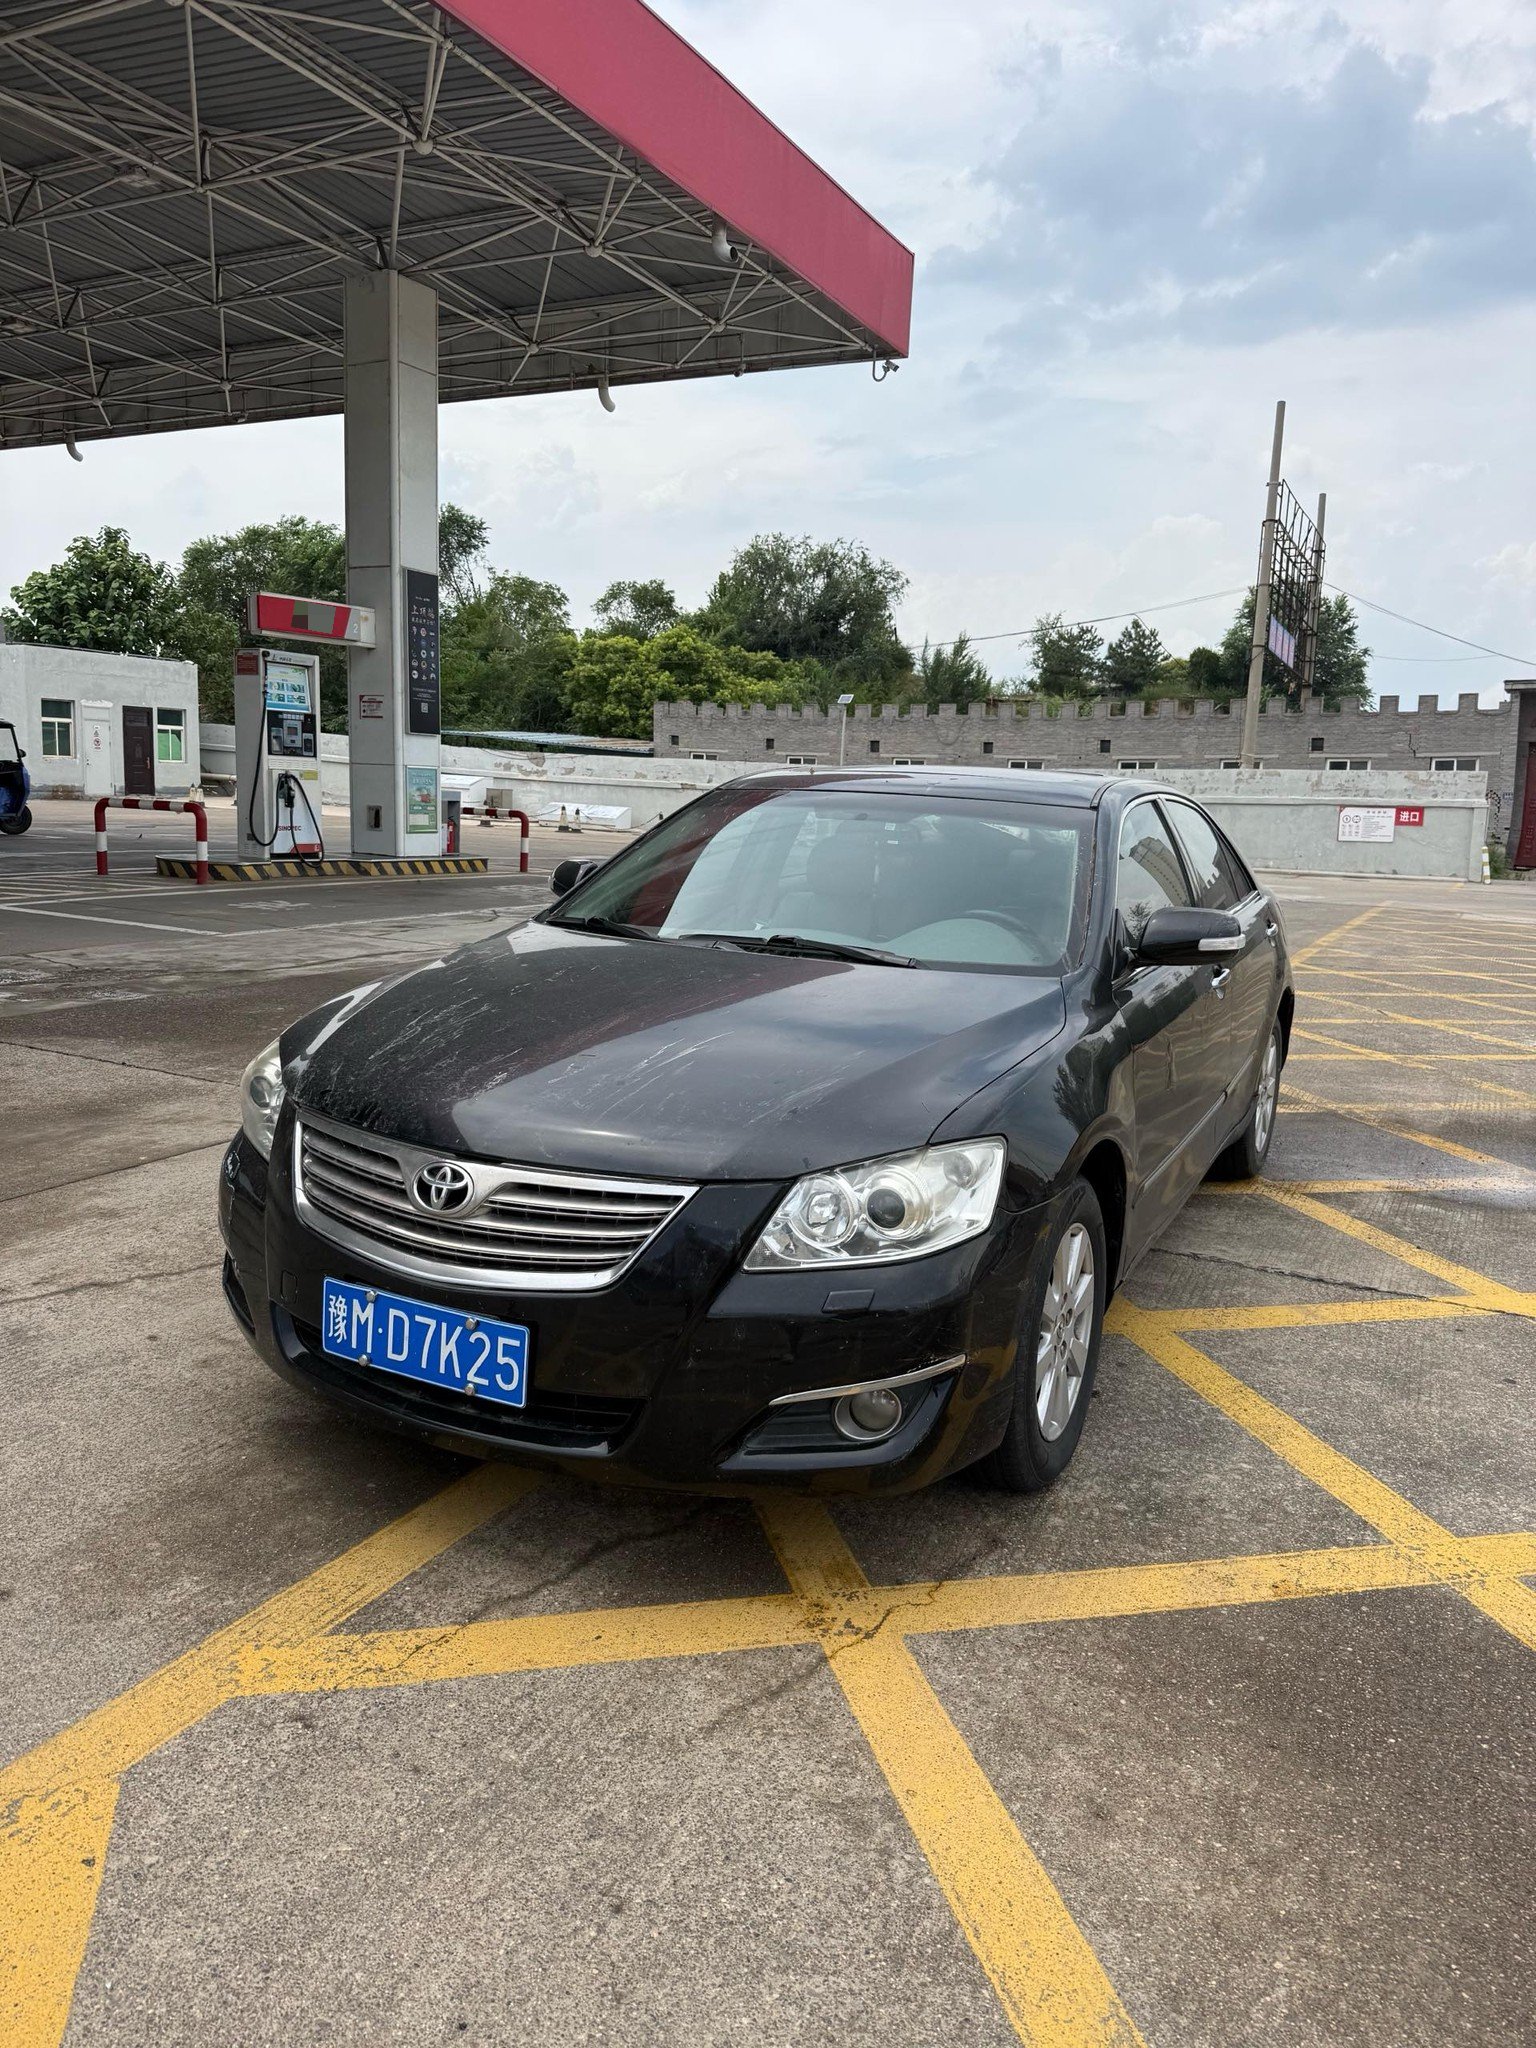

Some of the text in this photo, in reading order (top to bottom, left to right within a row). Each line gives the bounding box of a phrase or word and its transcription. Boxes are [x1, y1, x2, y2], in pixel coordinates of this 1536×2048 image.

[352, 622, 359, 634] 2
[1399, 810, 1420, 823] 进口
[328, 1294, 521, 1391] 豫M·D7K25
